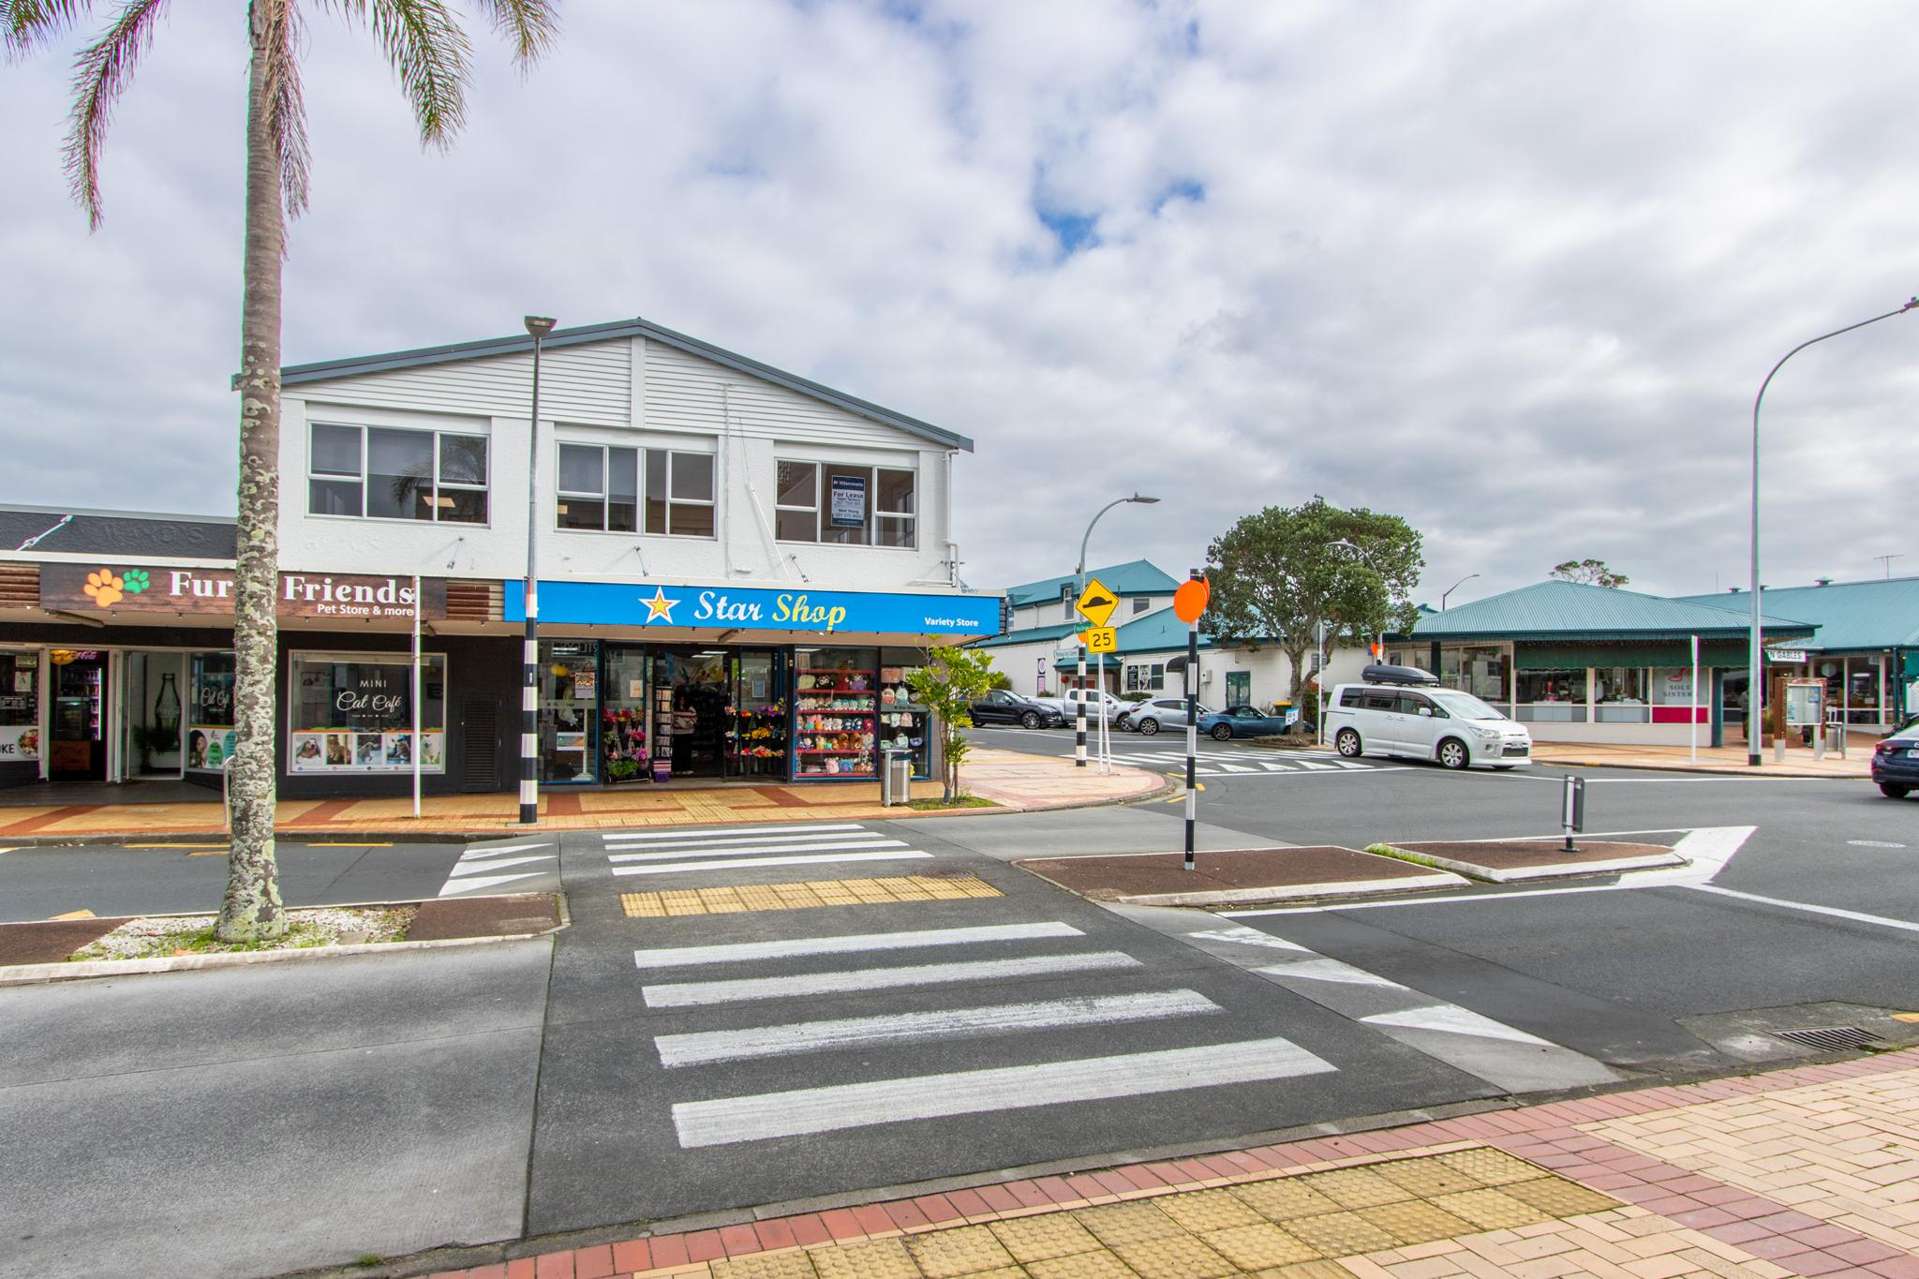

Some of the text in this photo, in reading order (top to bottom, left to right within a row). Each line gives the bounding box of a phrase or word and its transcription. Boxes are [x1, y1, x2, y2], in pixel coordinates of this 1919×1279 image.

[283, 575, 412, 605] Friends
[317, 603, 414, 617] Pet Store & more
[694, 590, 847, 632] Star Shop
[924, 617, 979, 628] Variety Store
[1092, 632, 1111, 647] 25
[360, 679, 387, 688] MINI
[336, 690, 369, 712] Cat
[0, 743, 15, 754] KE
